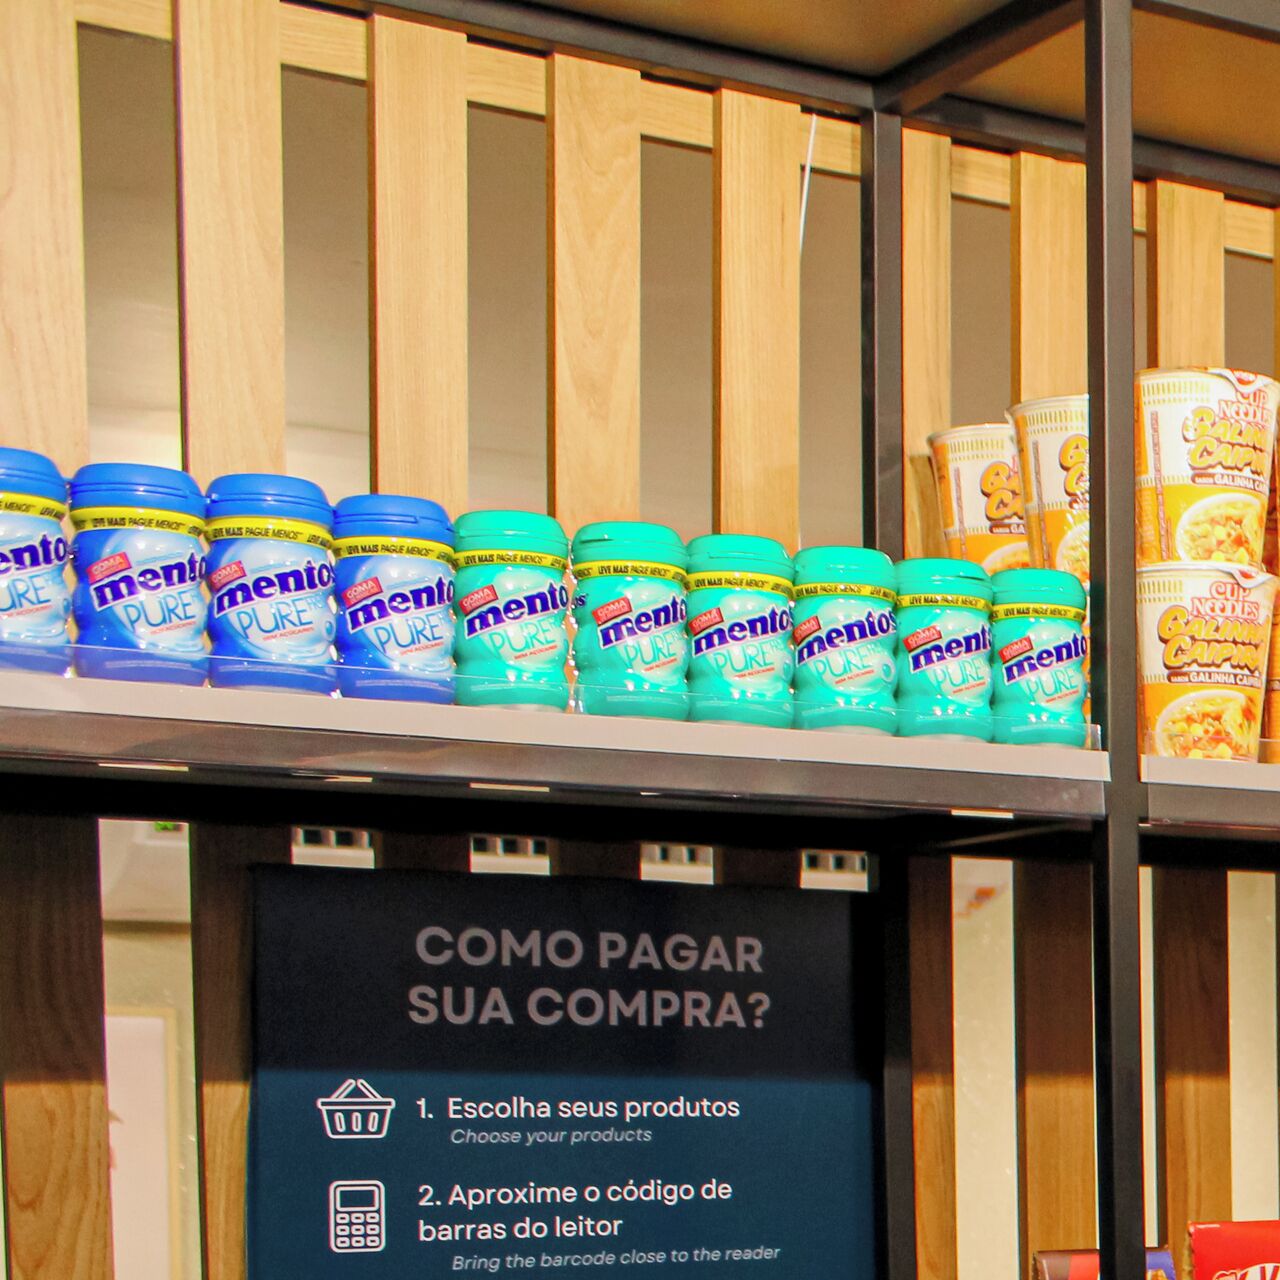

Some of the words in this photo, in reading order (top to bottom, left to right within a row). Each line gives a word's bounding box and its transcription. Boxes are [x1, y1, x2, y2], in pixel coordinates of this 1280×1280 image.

[93, 552, 206, 607] mento
[216, 560, 334, 615] mento
[1210, 581, 1250, 600] CUP
[124, 594, 196, 630] PURE
[238, 599, 312, 639] PURE
[349, 577, 454, 630] mento
[1191, 598, 1259, 621] NOODLES
[374, 615, 443, 653] PURE
[416, 927, 583, 968] COMO
[600, 932, 762, 972] PAGAR
[408, 985, 513, 1025] SUA
[527, 988, 770, 1028] COMPRA?
[416, 1098, 433, 1119] 1.
[447, 1096, 551, 1119] Escolha
[558, 1101, 617, 1119] seus
[625, 1097, 740, 1121] produtos
[451, 1129, 521, 1144] Choose
[526, 1131, 566, 1146] your
[571, 1128, 651, 1146] products
[419, 1185, 441, 1206] 2.
[448, 1183, 577, 1209] Aproxime
[584, 1187, 600, 1202] o
[607, 1179, 694, 1205] código
[701, 1178, 732, 1200] de
[419, 1219, 506, 1241] barras
[513, 1217, 547, 1238] do
[555, 1216, 622, 1237] leitor
[452, 1255, 500, 1272] Bring
[505, 1253, 535, 1269] the
[540, 1251, 615, 1267] barcode
[619, 1249, 666, 1264] close
[670, 1248, 688, 1262] to
[693, 1247, 721, 1261] the
[725, 1246, 780, 1260] reader
